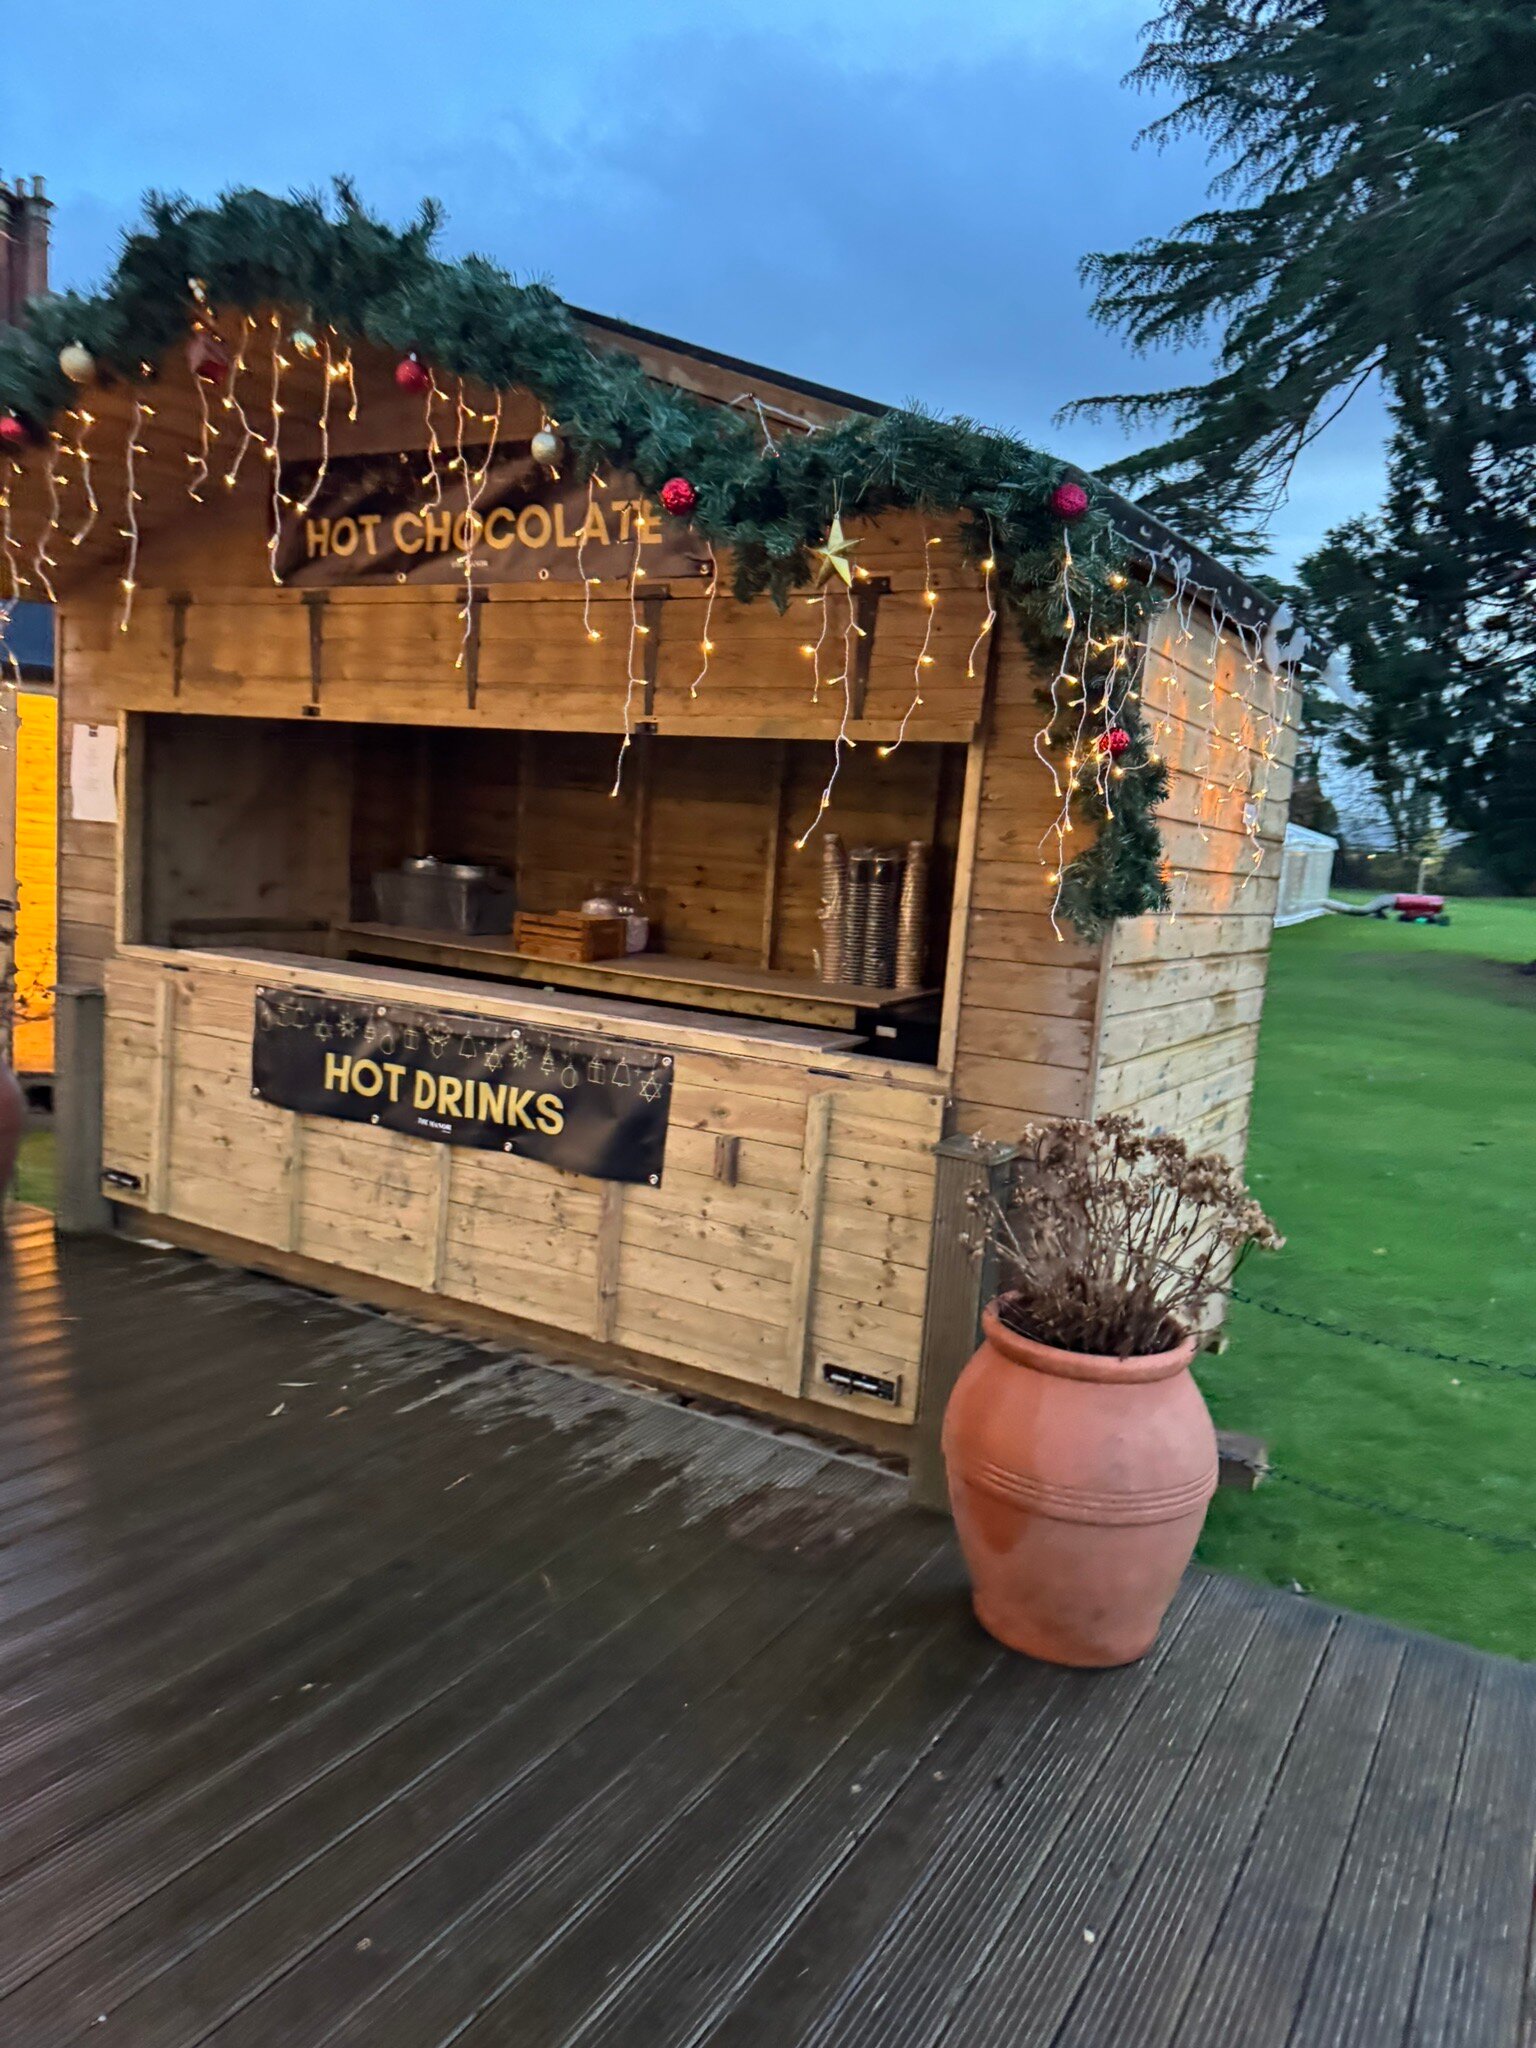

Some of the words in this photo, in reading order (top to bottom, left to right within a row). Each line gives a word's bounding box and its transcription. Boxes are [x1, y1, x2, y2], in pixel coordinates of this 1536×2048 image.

[305, 514, 382, 557] HOT
[392, 500, 663, 553] CHOCOLATE
[324, 1052, 406, 1102] HOT
[412, 1069, 565, 1135] DRINKS
